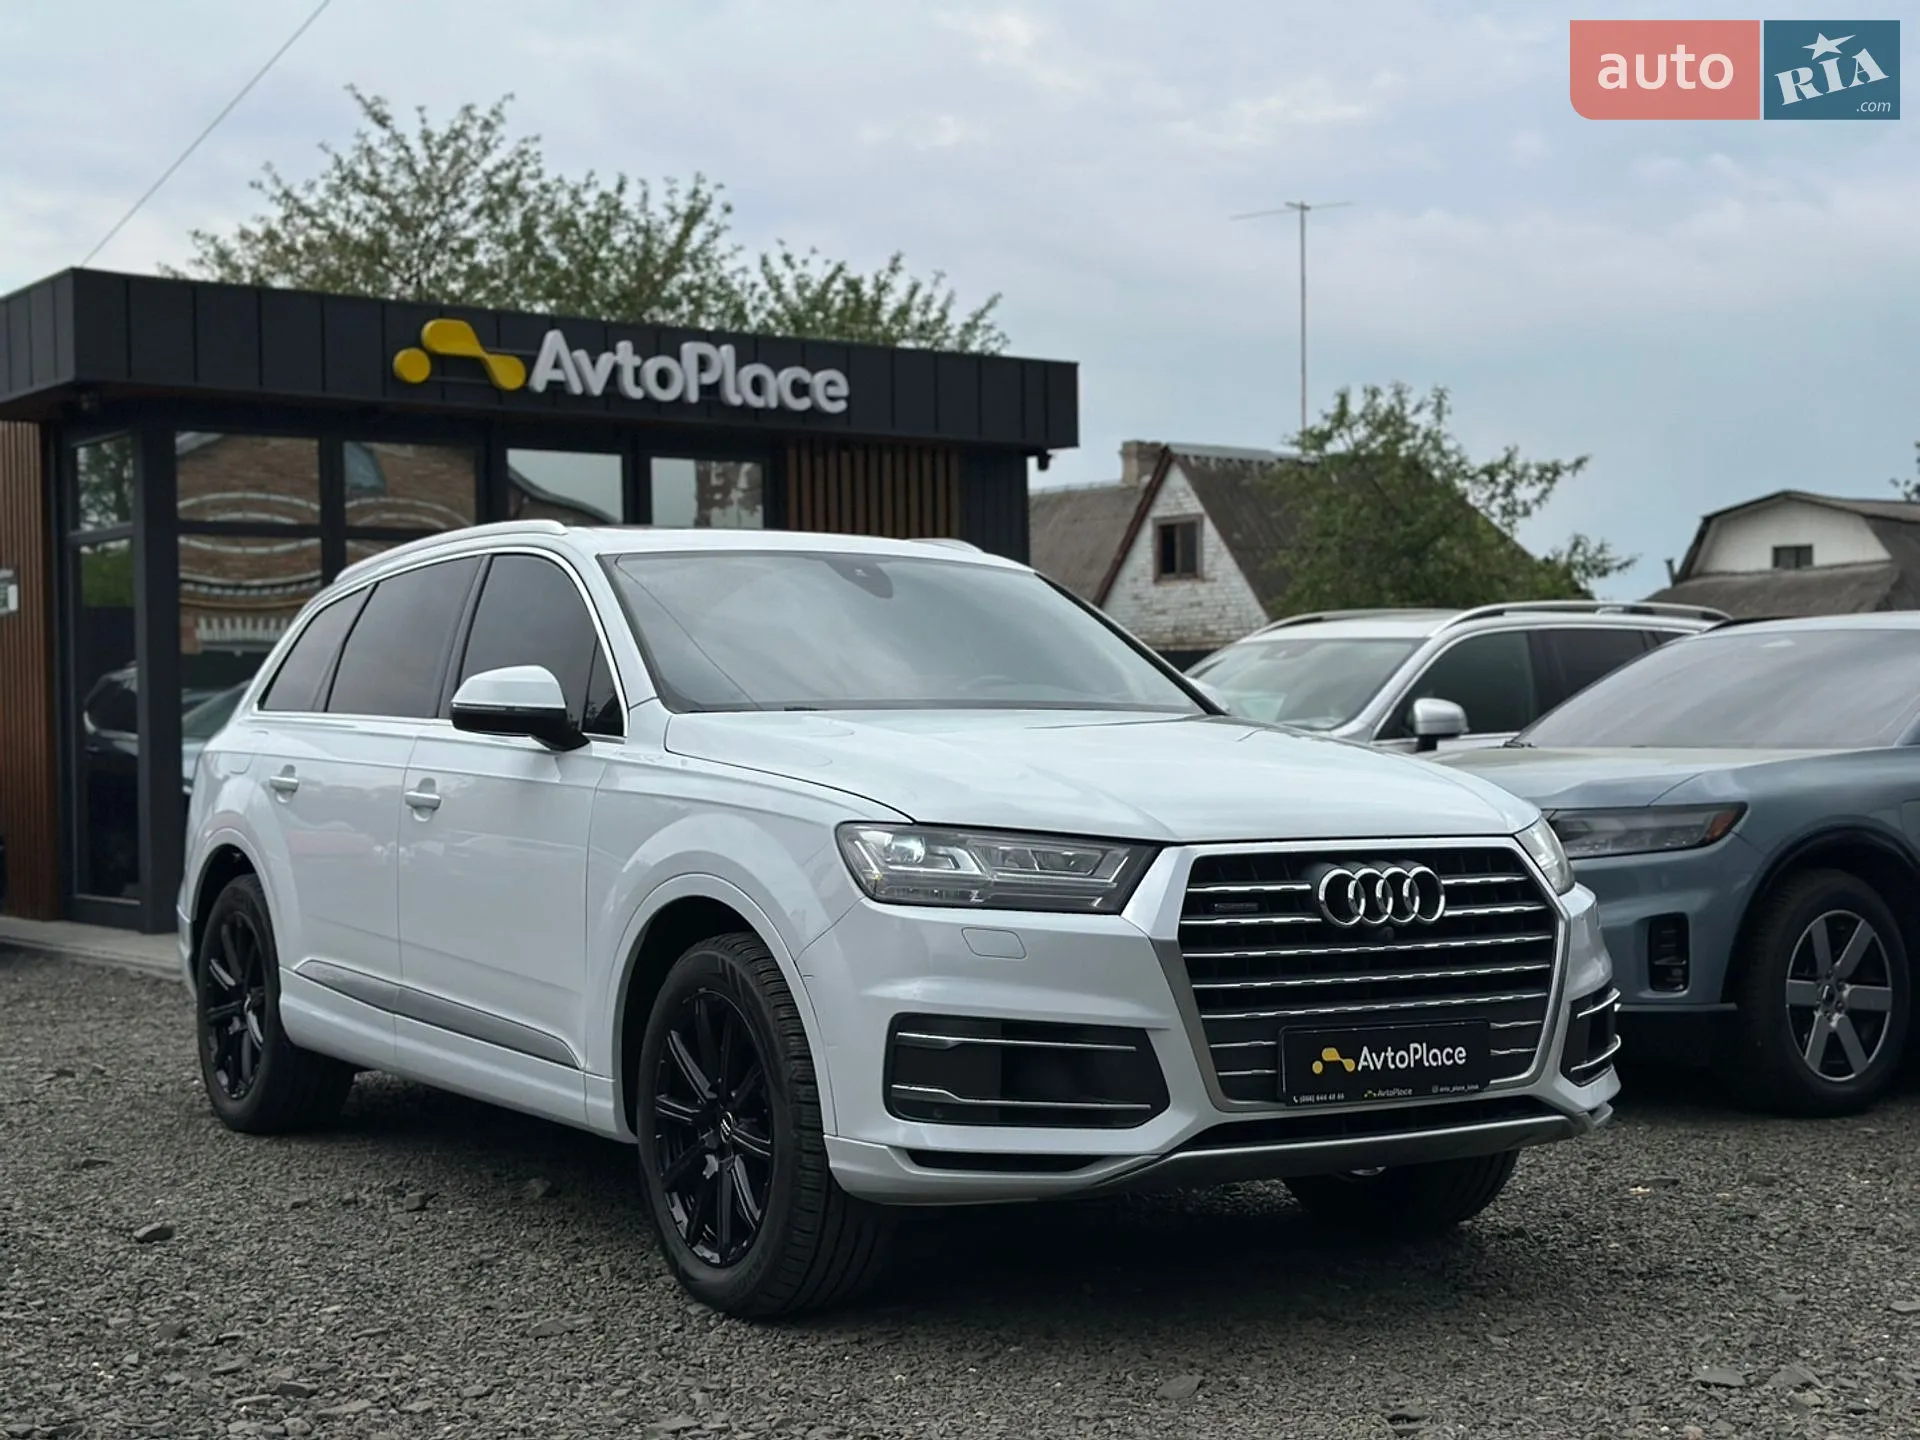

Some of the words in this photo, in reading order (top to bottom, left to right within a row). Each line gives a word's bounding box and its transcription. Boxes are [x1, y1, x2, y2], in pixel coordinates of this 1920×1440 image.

[528, 328, 850, 414] AvtoPlace
[1357, 1042, 1467, 1072] AvtoPlace
[1377, 1087, 1413, 1097] AvtoPlace
